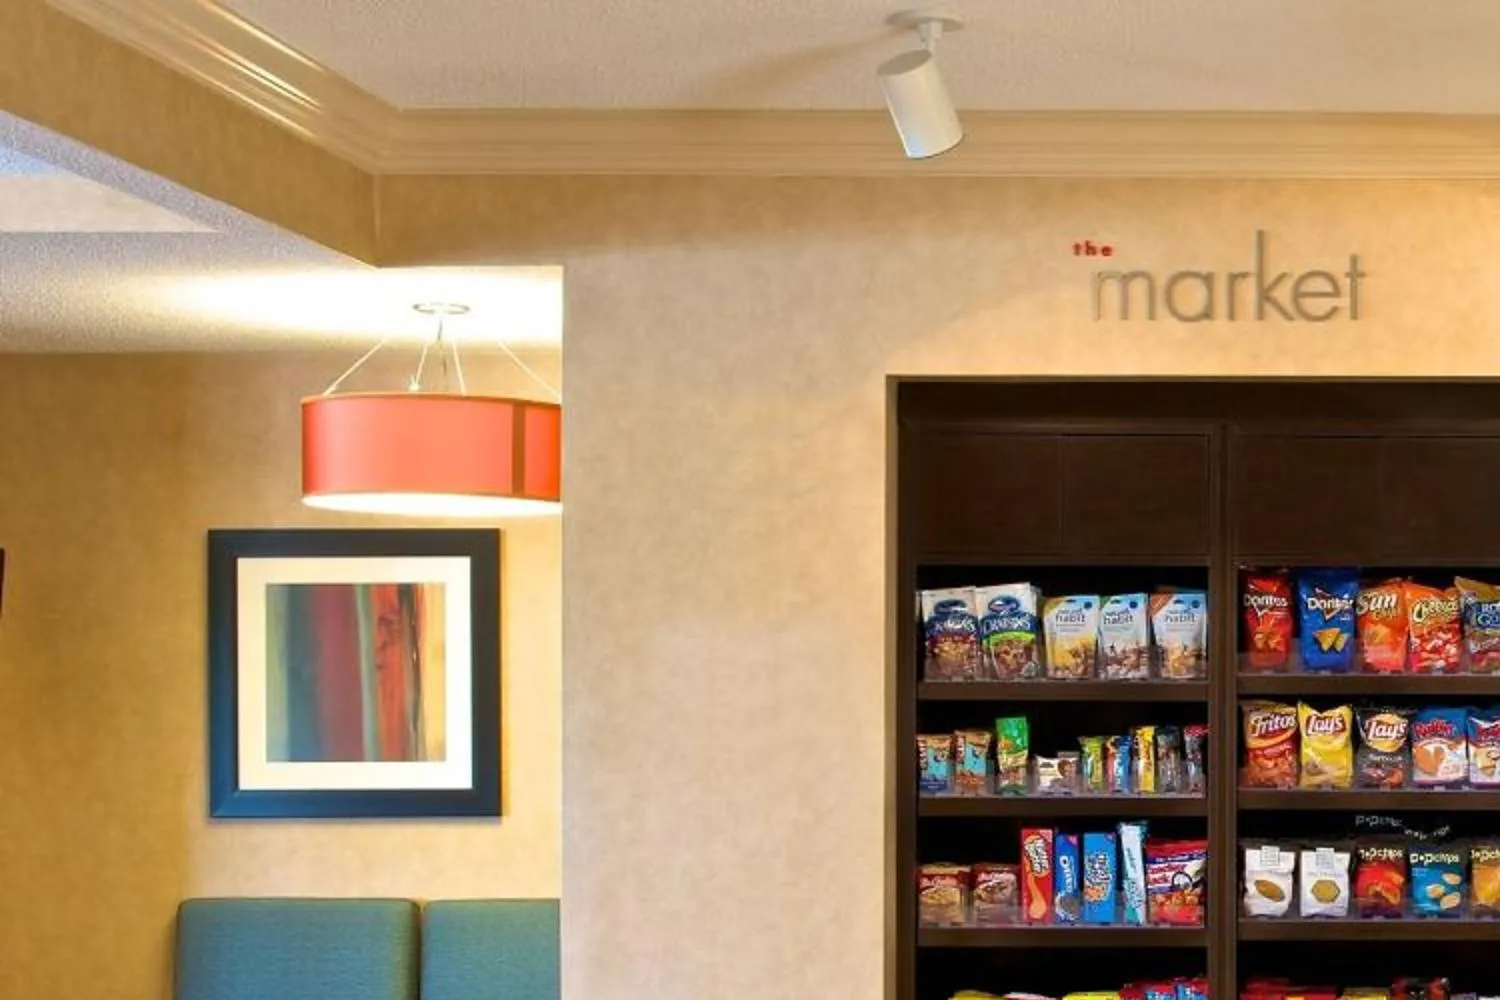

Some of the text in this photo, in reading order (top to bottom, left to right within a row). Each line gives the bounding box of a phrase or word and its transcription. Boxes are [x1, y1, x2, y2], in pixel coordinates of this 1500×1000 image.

[1073, 241, 1113, 256] the
[1091, 230, 1366, 322] market
[1250, 713, 1296, 737] Fritos
